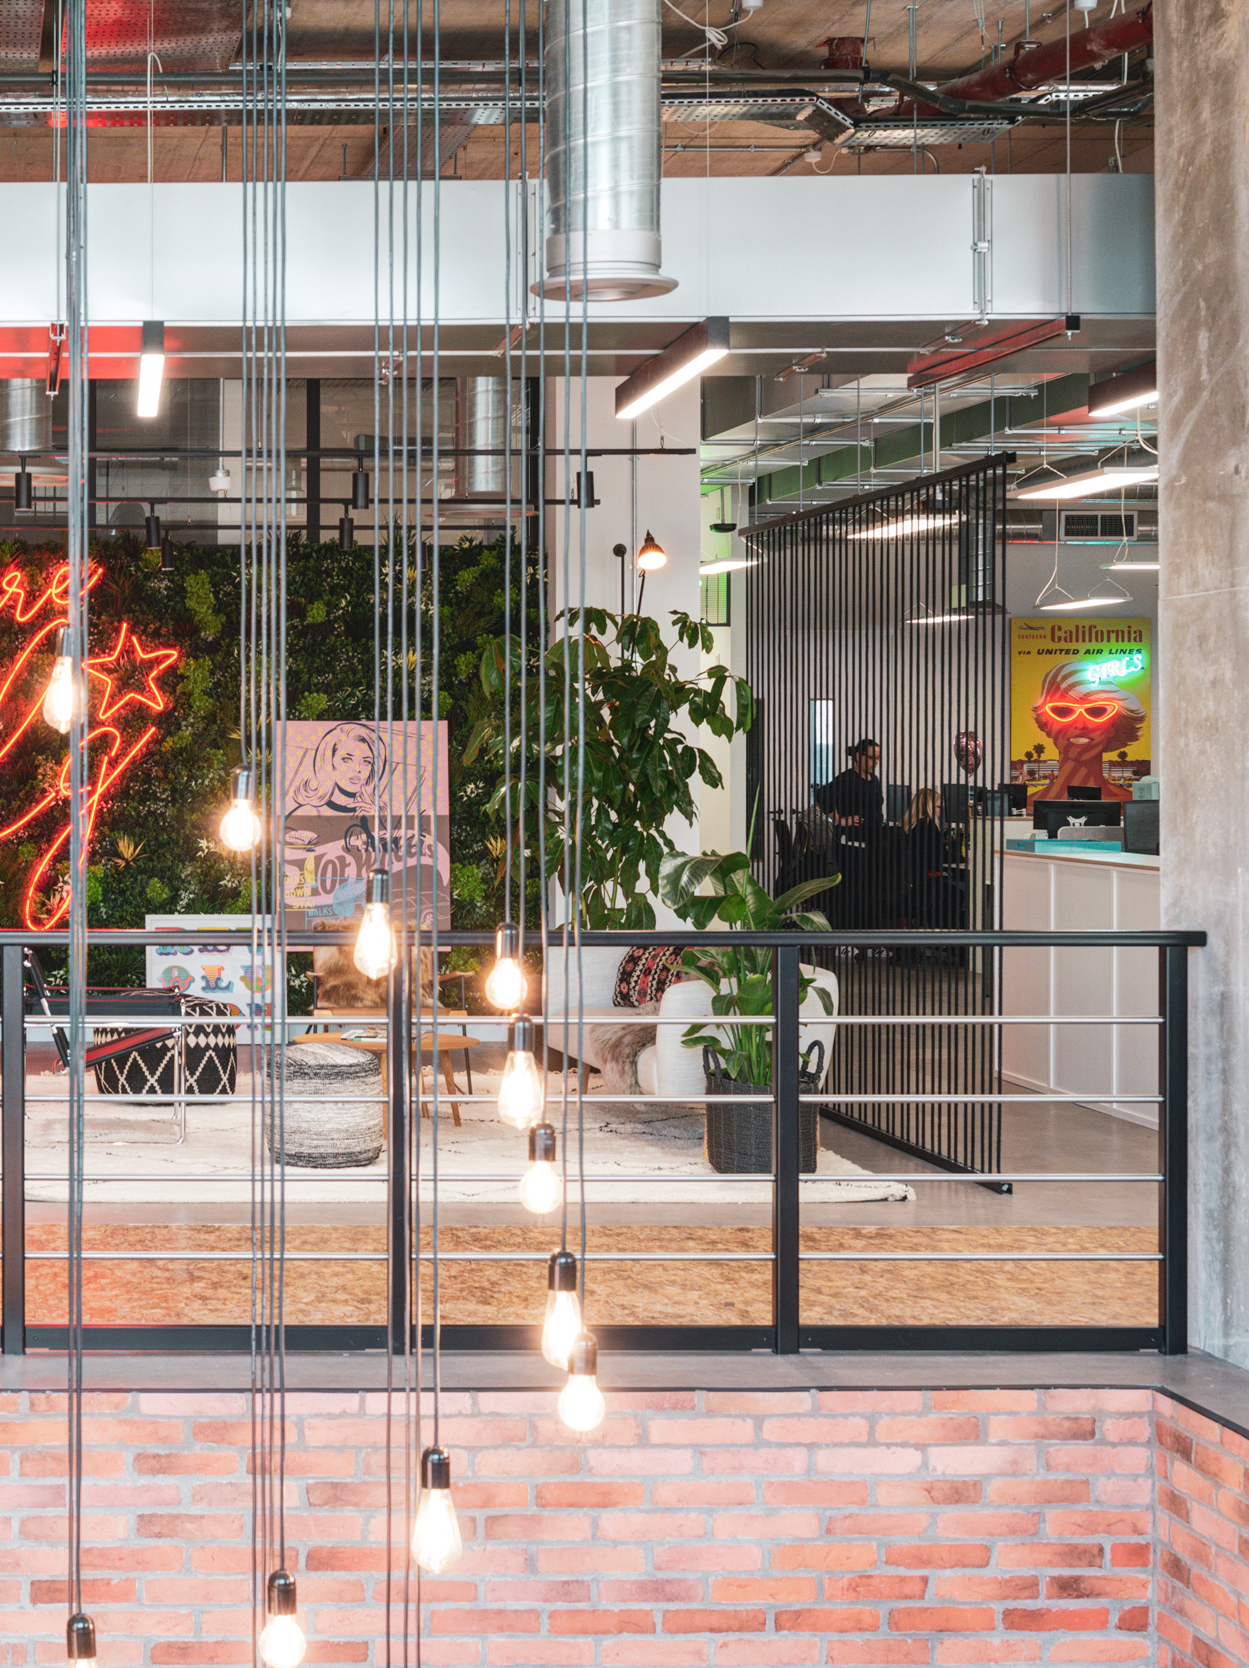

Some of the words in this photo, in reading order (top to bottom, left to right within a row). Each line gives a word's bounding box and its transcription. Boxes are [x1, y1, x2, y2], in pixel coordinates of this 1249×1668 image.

[1050, 624, 1144, 643] California
[1037, 648, 1080, 656] UNITED
[1087, 653, 1144, 687] GIRLS
[292, 901, 316, 909] STA
[307, 906, 334, 917] WALKS
